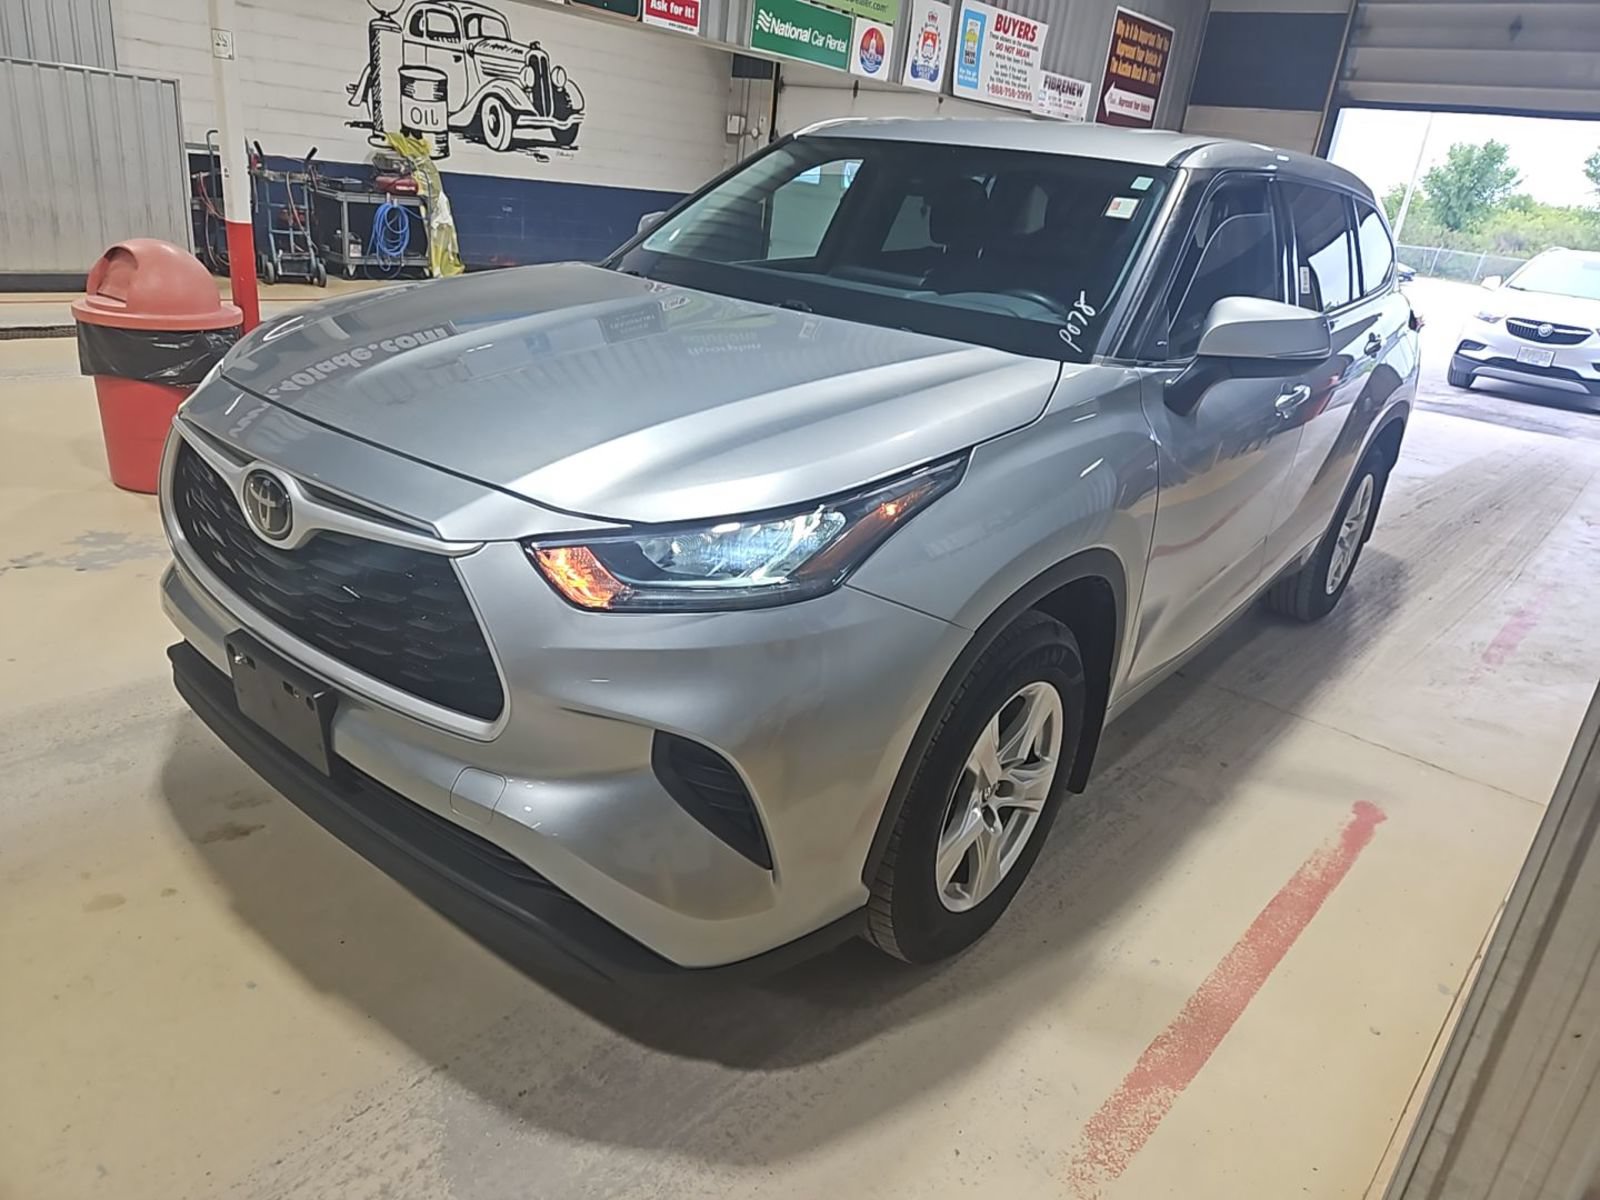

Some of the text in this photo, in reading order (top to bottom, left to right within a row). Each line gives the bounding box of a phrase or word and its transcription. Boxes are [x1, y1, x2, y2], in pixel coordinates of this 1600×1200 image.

[650, 0, 695, 19] Ask for it!
[770, 17, 848, 53] National Car Rental
[994, 13, 1038, 42] BUYERS
[995, 41, 1004, 51] DO
[1004, 44, 1015, 54] NOT
[1016, 48, 1030, 58] MEAN
[1043, 74, 1085, 98] FIBRENEW
[410, 106, 439, 126] OIL
